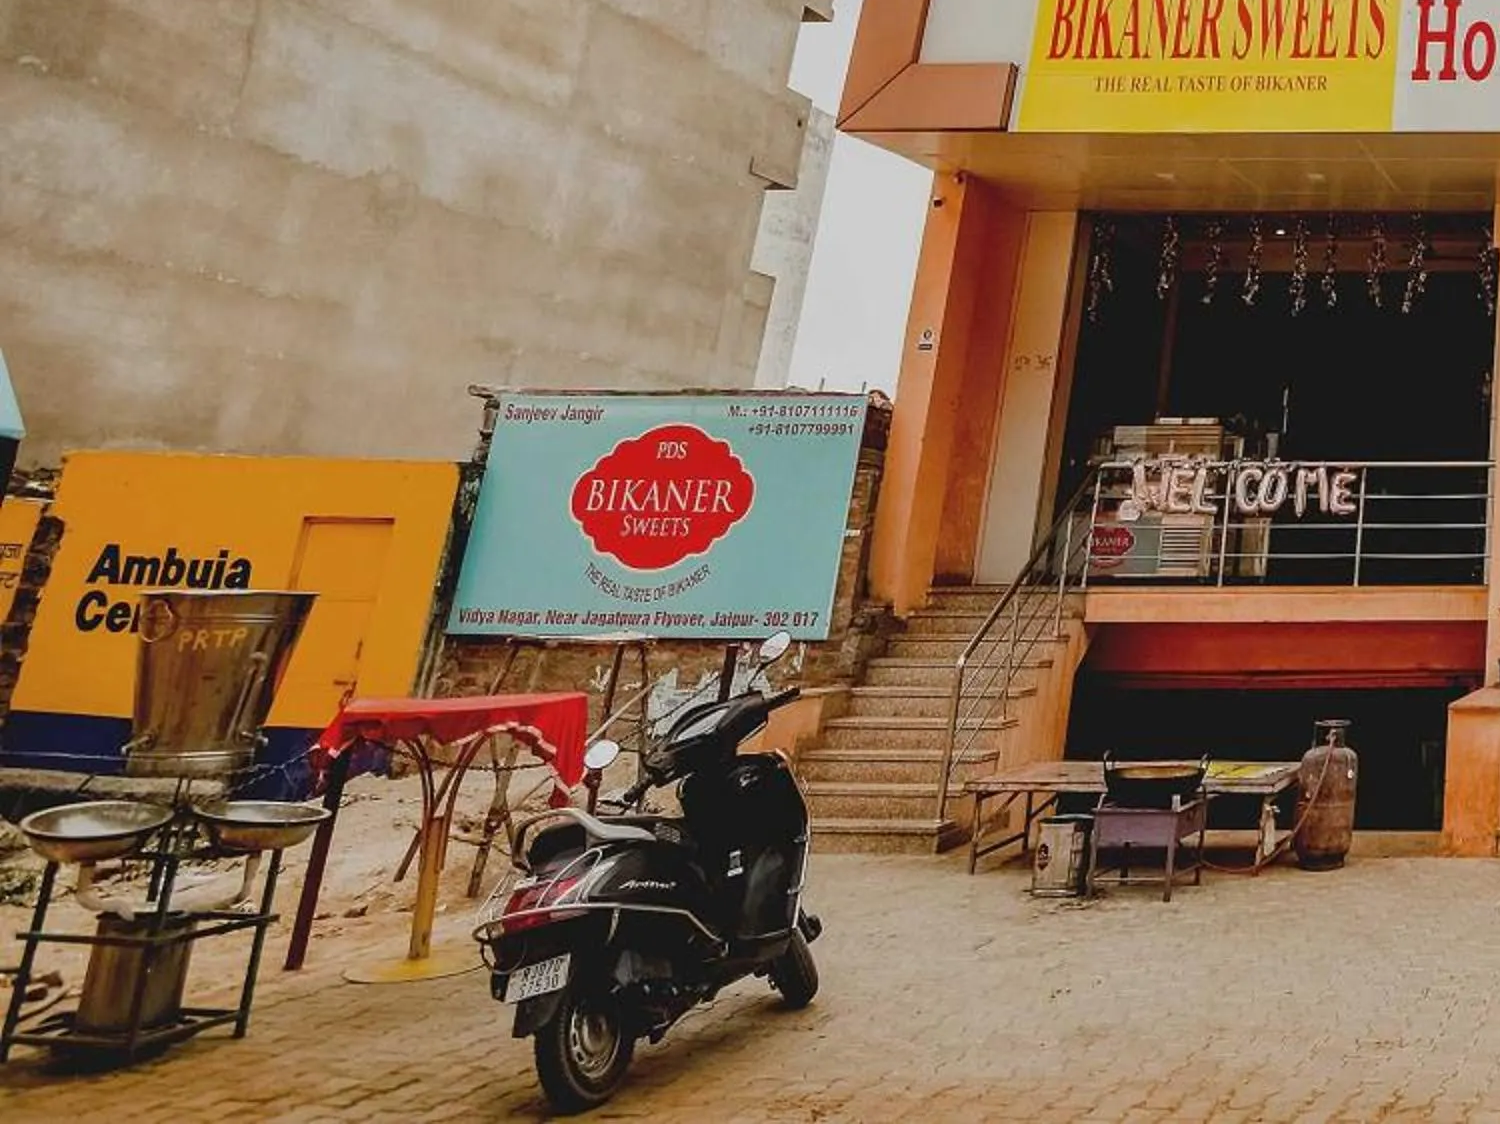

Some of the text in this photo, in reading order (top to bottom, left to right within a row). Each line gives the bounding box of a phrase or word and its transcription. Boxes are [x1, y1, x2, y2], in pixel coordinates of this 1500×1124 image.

[1094, 75, 1328, 93] THE REAL TASTE OF BIKANER
[504, 403, 604, 424] Sanjeev Jangir
[656, 441, 688, 460] PDS
[585, 478, 735, 513] BIKANER
[619, 514, 692, 537] SWEETS
[458, 607, 495, 626] Vidya
[498, 608, 541, 627] Nagar,
[545, 609, 579, 625] Near
[764, 611, 789, 627] 302
[793, 611, 819, 627] 017
